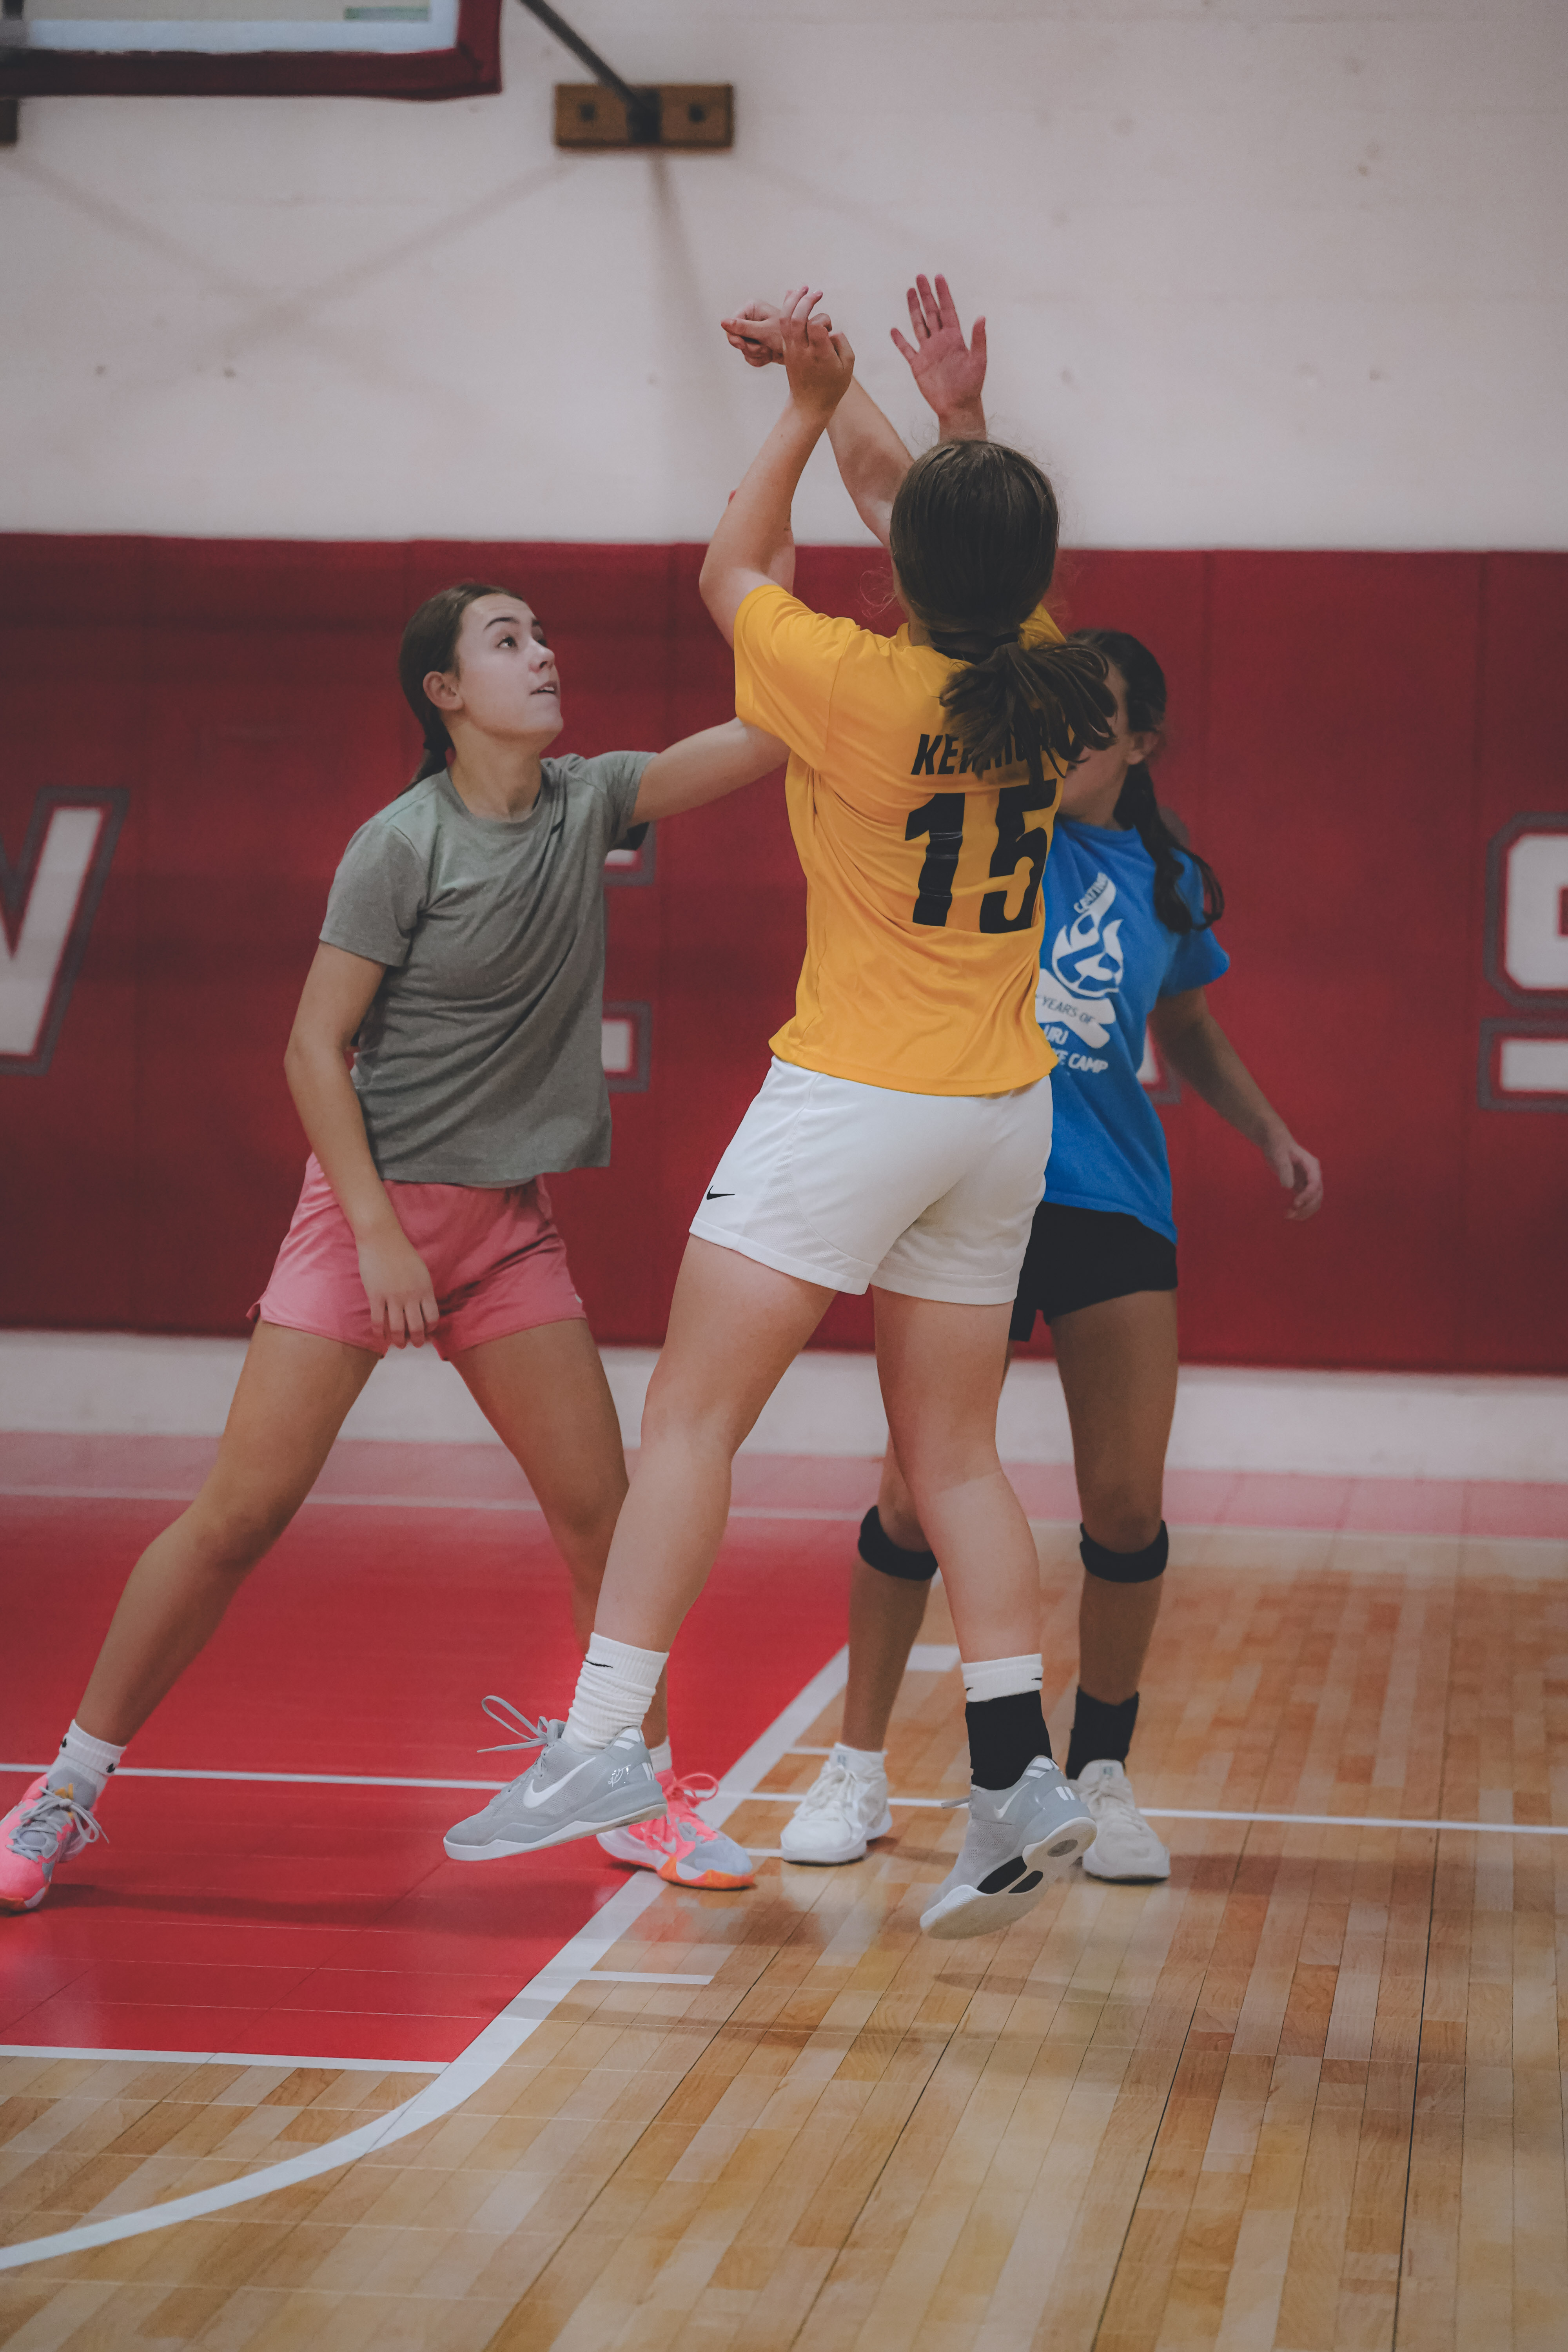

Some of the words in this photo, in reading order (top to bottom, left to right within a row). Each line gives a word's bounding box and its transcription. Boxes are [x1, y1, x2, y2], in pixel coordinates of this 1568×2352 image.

[905, 778, 1057, 934] 15
[1042, 996, 1078, 1018] YEARS
[1079, 1013, 1096, 1024] OF
[1068, 1053, 1109, 1073] CAMP
